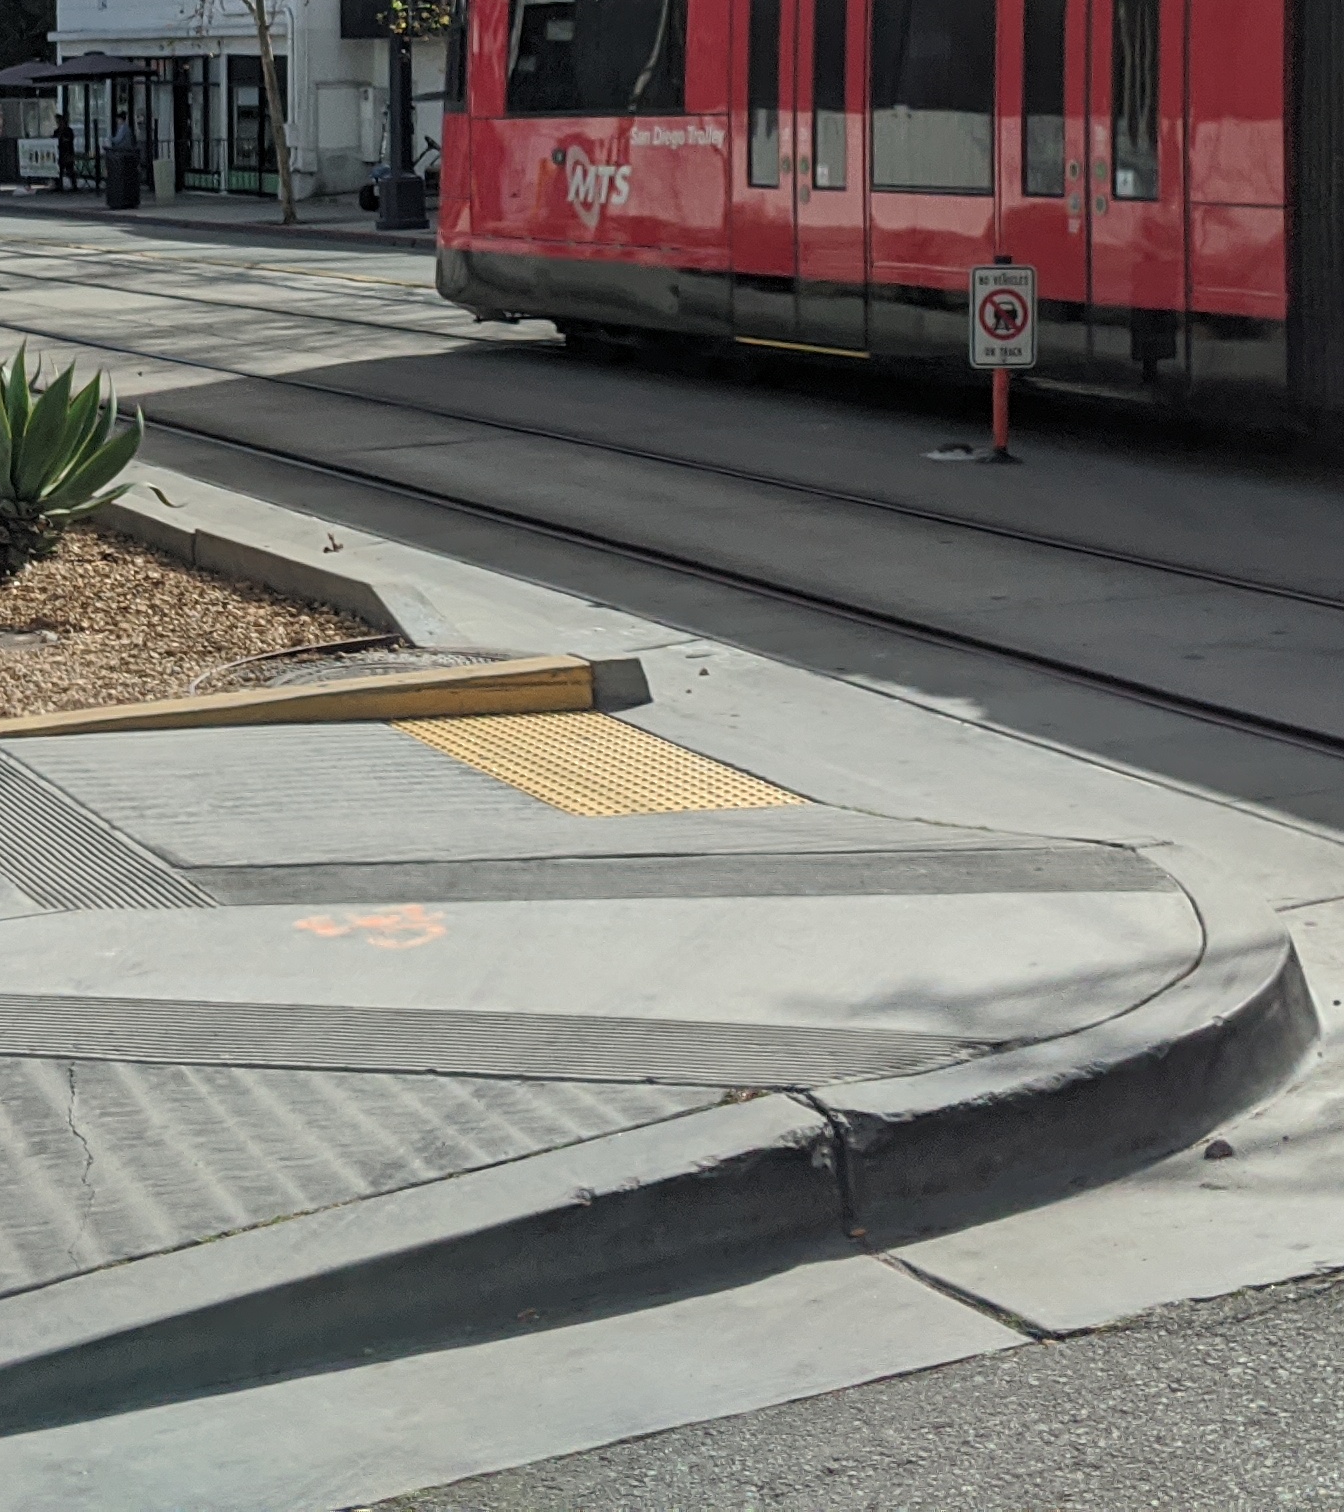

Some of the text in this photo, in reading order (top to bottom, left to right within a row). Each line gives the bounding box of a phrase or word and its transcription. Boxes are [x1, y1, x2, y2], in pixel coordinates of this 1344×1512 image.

[631, 125, 725, 149] San Diego Trolley
[567, 165, 632, 205] MTS
[979, 274, 1029, 286] NO VEHICLES
